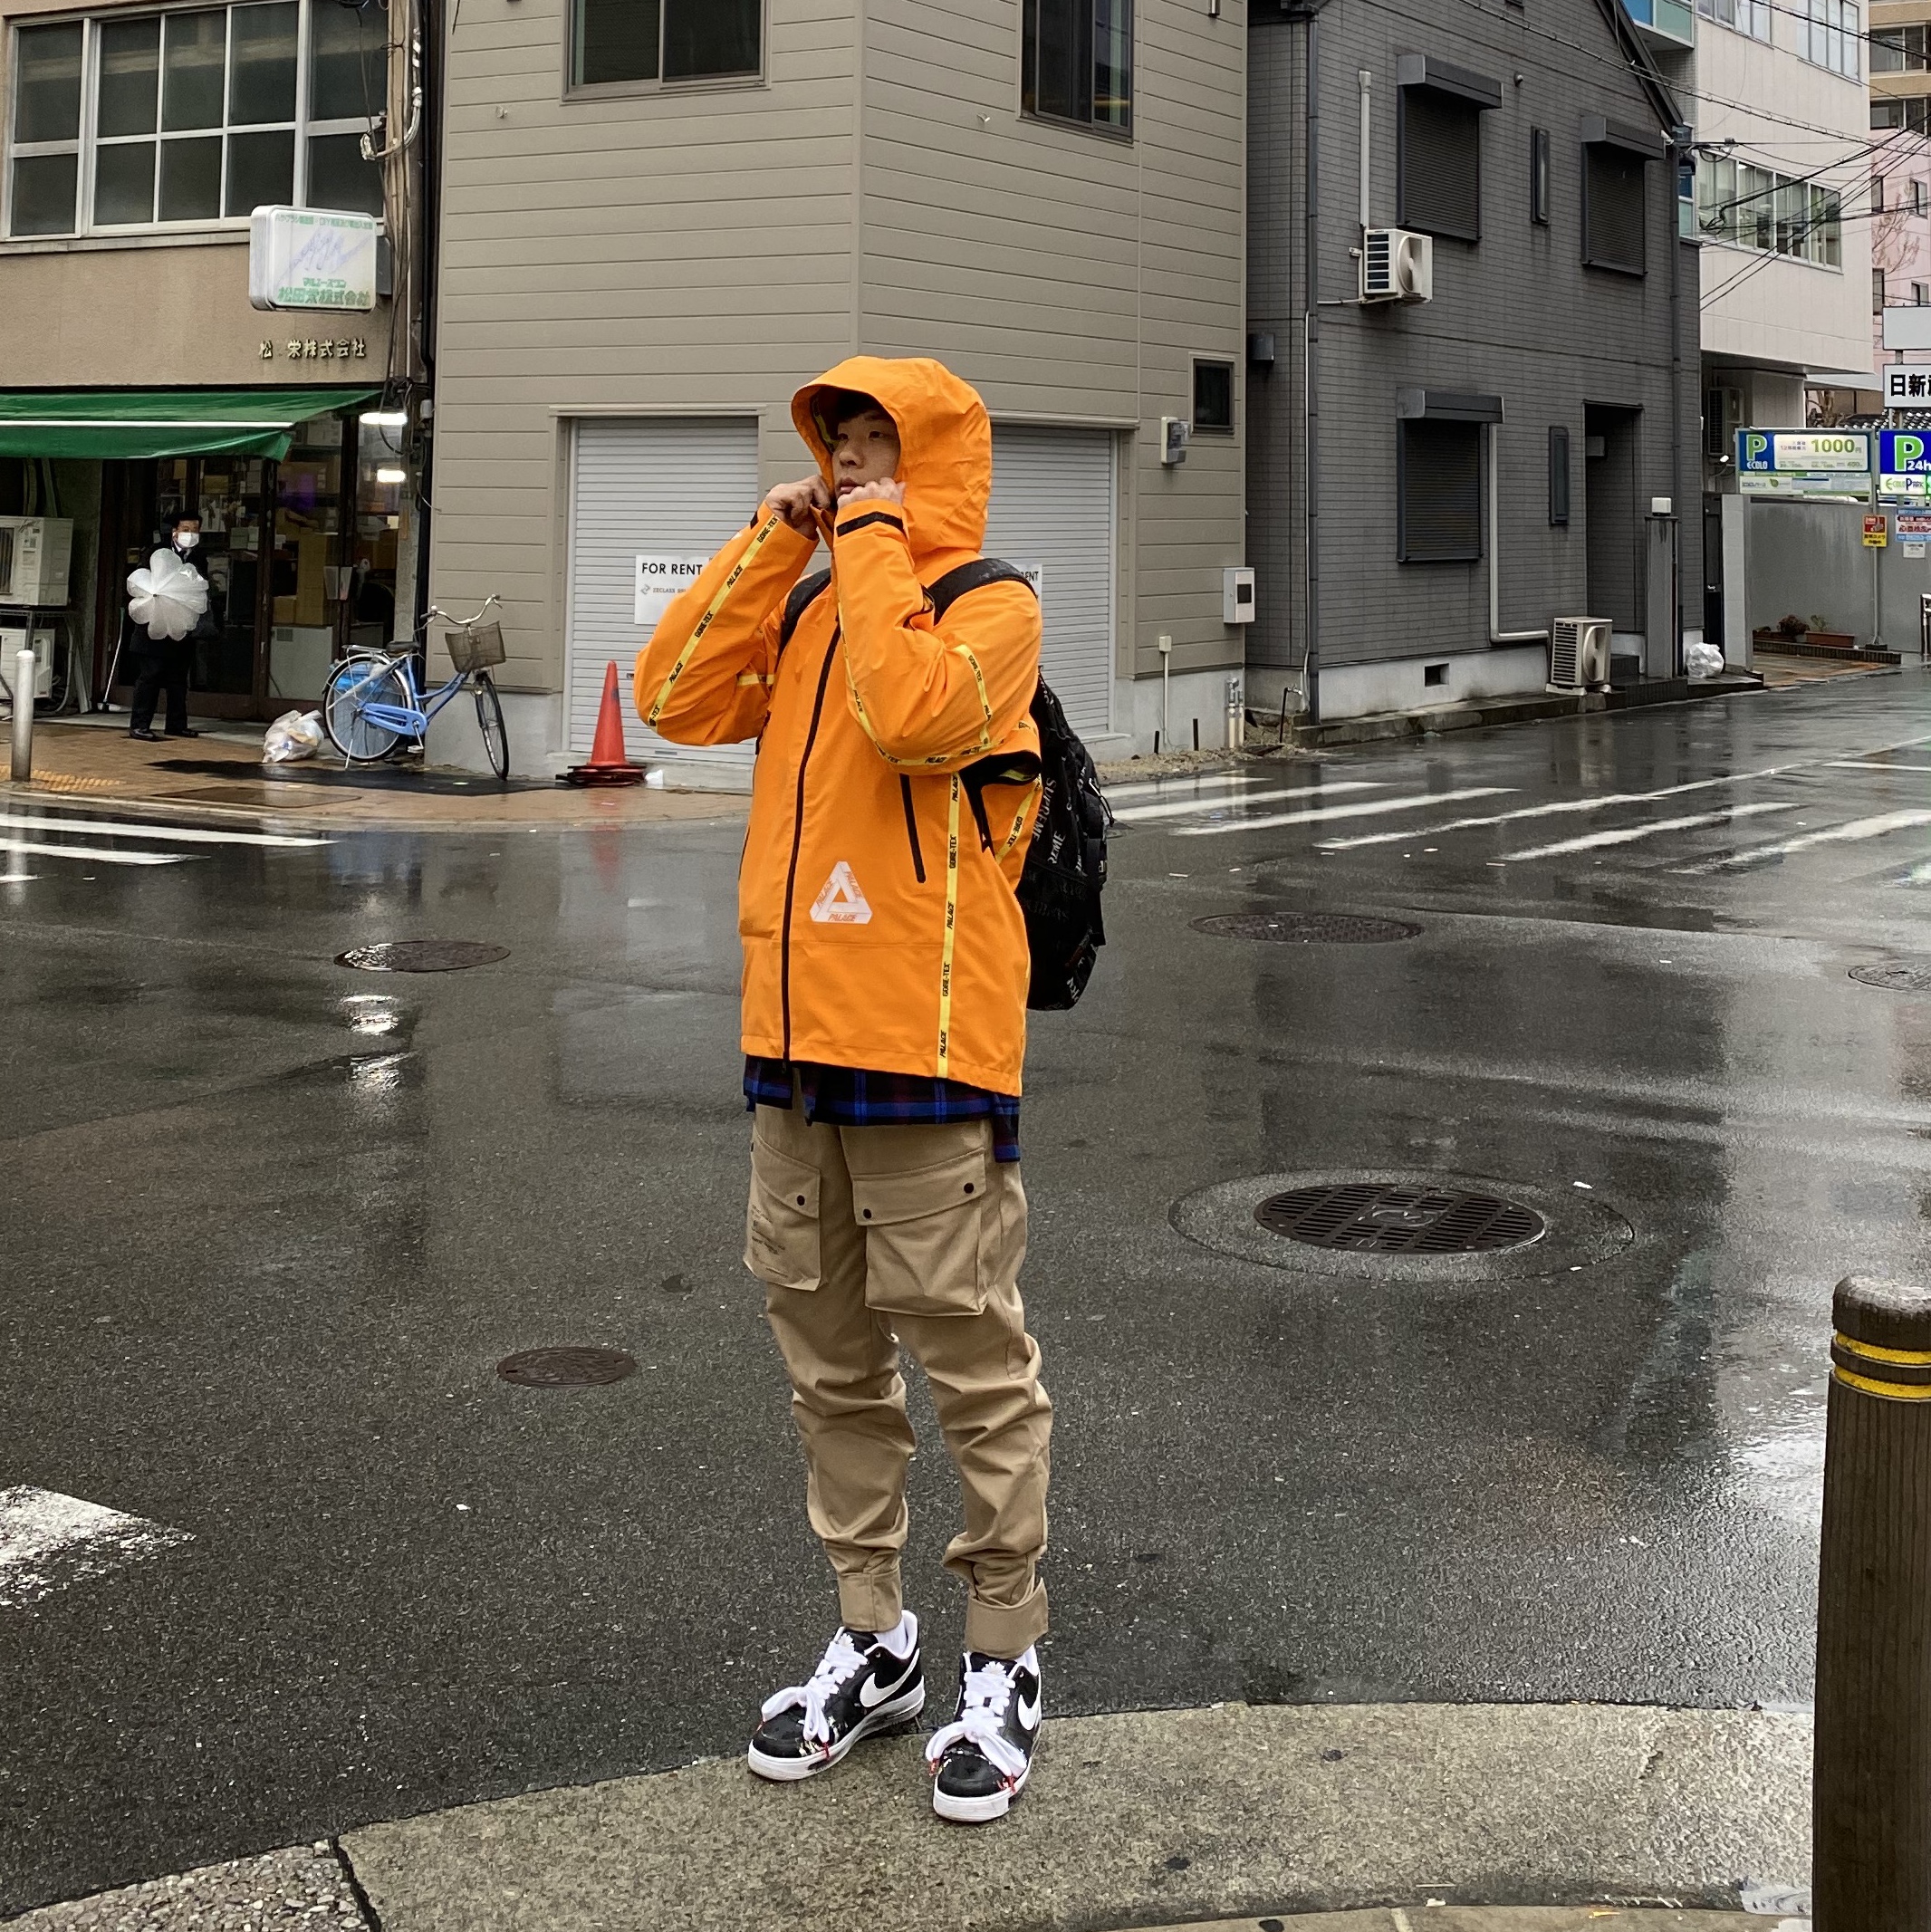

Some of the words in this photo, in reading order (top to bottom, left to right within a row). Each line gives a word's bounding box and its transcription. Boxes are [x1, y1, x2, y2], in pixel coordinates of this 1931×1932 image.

[1890, 374, 1931, 397] 日新
[1746, 435, 1767, 461] P
[1894, 436, 1924, 471] P
[757, 516, 778, 543] GORE-TEX
[642, 562, 666, 574] FOR
[671, 563, 703, 575] RENT
[726, 564, 743, 589] PALACE
[694, 610, 715, 639] GORE-TEX
[668, 661, 684, 684] PALACE
[1033, 777, 1058, 842] SUPREME
[1006, 815, 1023, 848] GORE-TEX
[948, 833, 956, 870] GORE-TEX
[828, 913, 858, 922] PALACE
[946, 901, 956, 930] PALACE
[942, 962, 951, 997] GORE-TEX
[939, 1030, 947, 1058] PALACE
